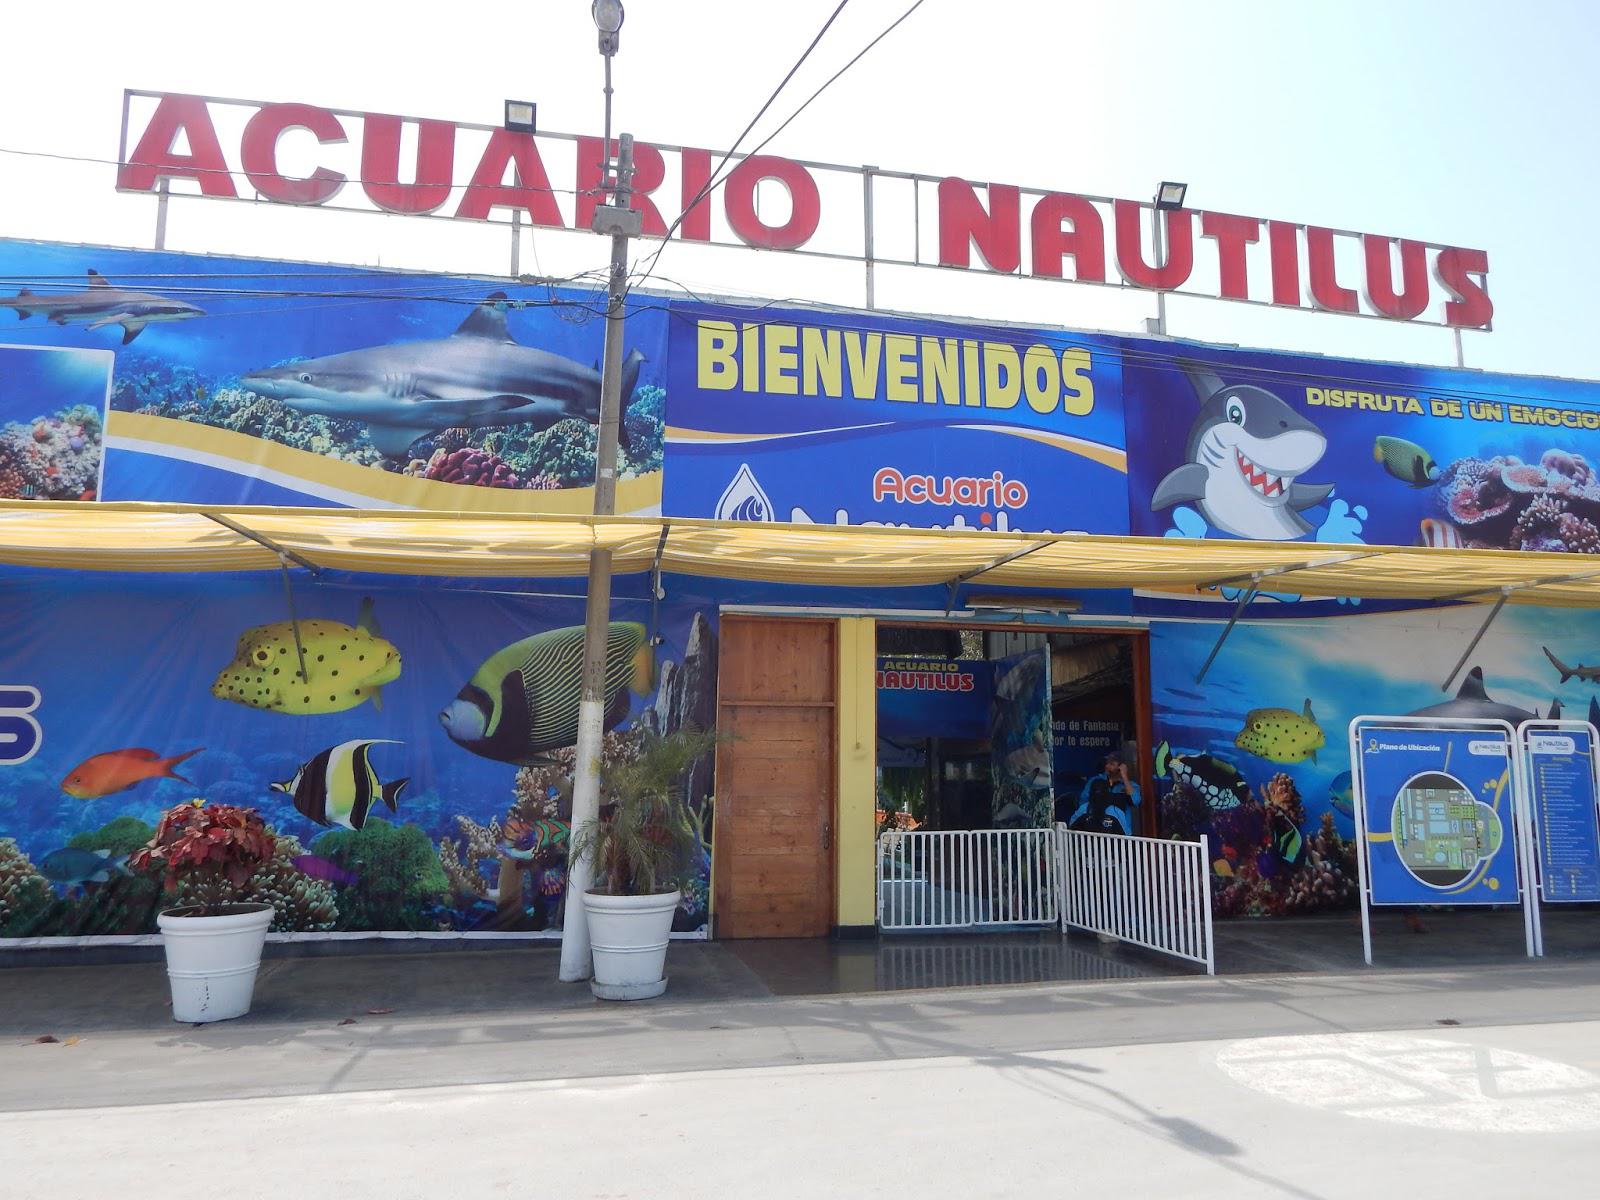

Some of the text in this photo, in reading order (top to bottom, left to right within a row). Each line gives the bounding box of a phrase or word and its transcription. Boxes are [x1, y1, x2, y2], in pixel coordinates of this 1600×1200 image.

[116, 92, 1494, 330] ACUARIO NAUTILUS
[697, 319, 1096, 416] BIENVENIDOS
[1305, 386, 1600, 430] DISFRUTA DE UN EMOCIO
[873, 467, 1028, 509] Acuario
[883, 661, 959, 672] ACUARIO
